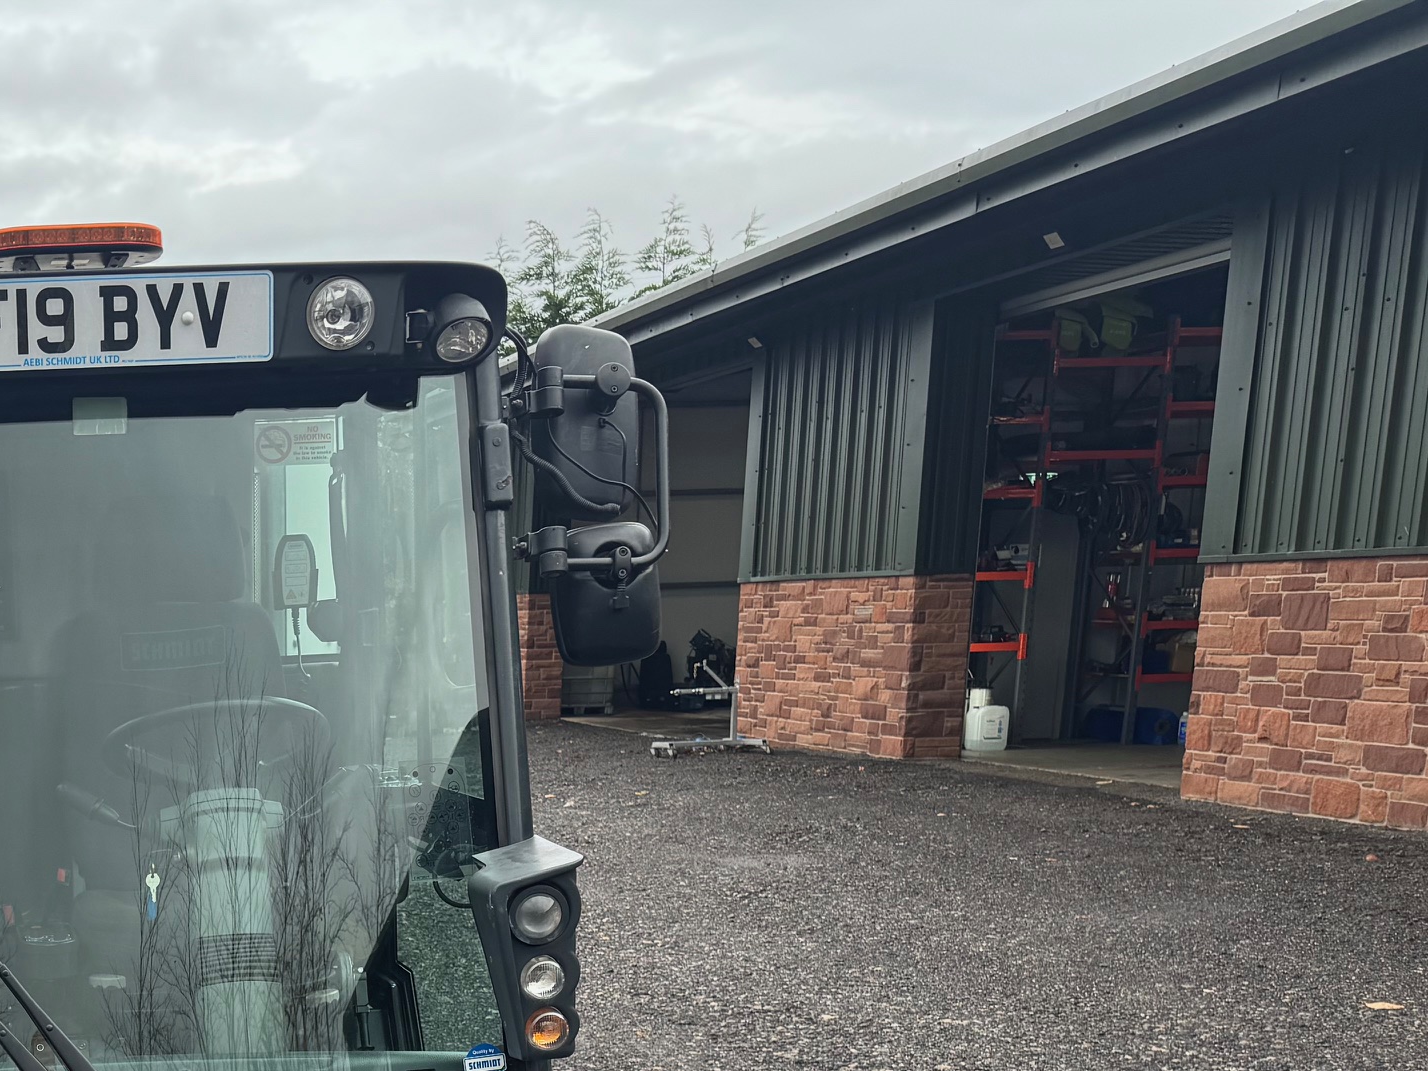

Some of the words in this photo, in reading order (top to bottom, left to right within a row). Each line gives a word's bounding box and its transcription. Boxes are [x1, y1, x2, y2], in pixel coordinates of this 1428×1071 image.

[98, 281, 231, 352] BYV
[23, 357, 44, 367] AEBI
[45, 355, 87, 366] SCHMIDT
[89, 355, 102, 365] UK
[104, 354, 120, 364] LTD
[307, 425, 319, 433] NO
[293, 433, 331, 441] SMOKING
[468, 1058, 501, 1070] SCHMIDT
